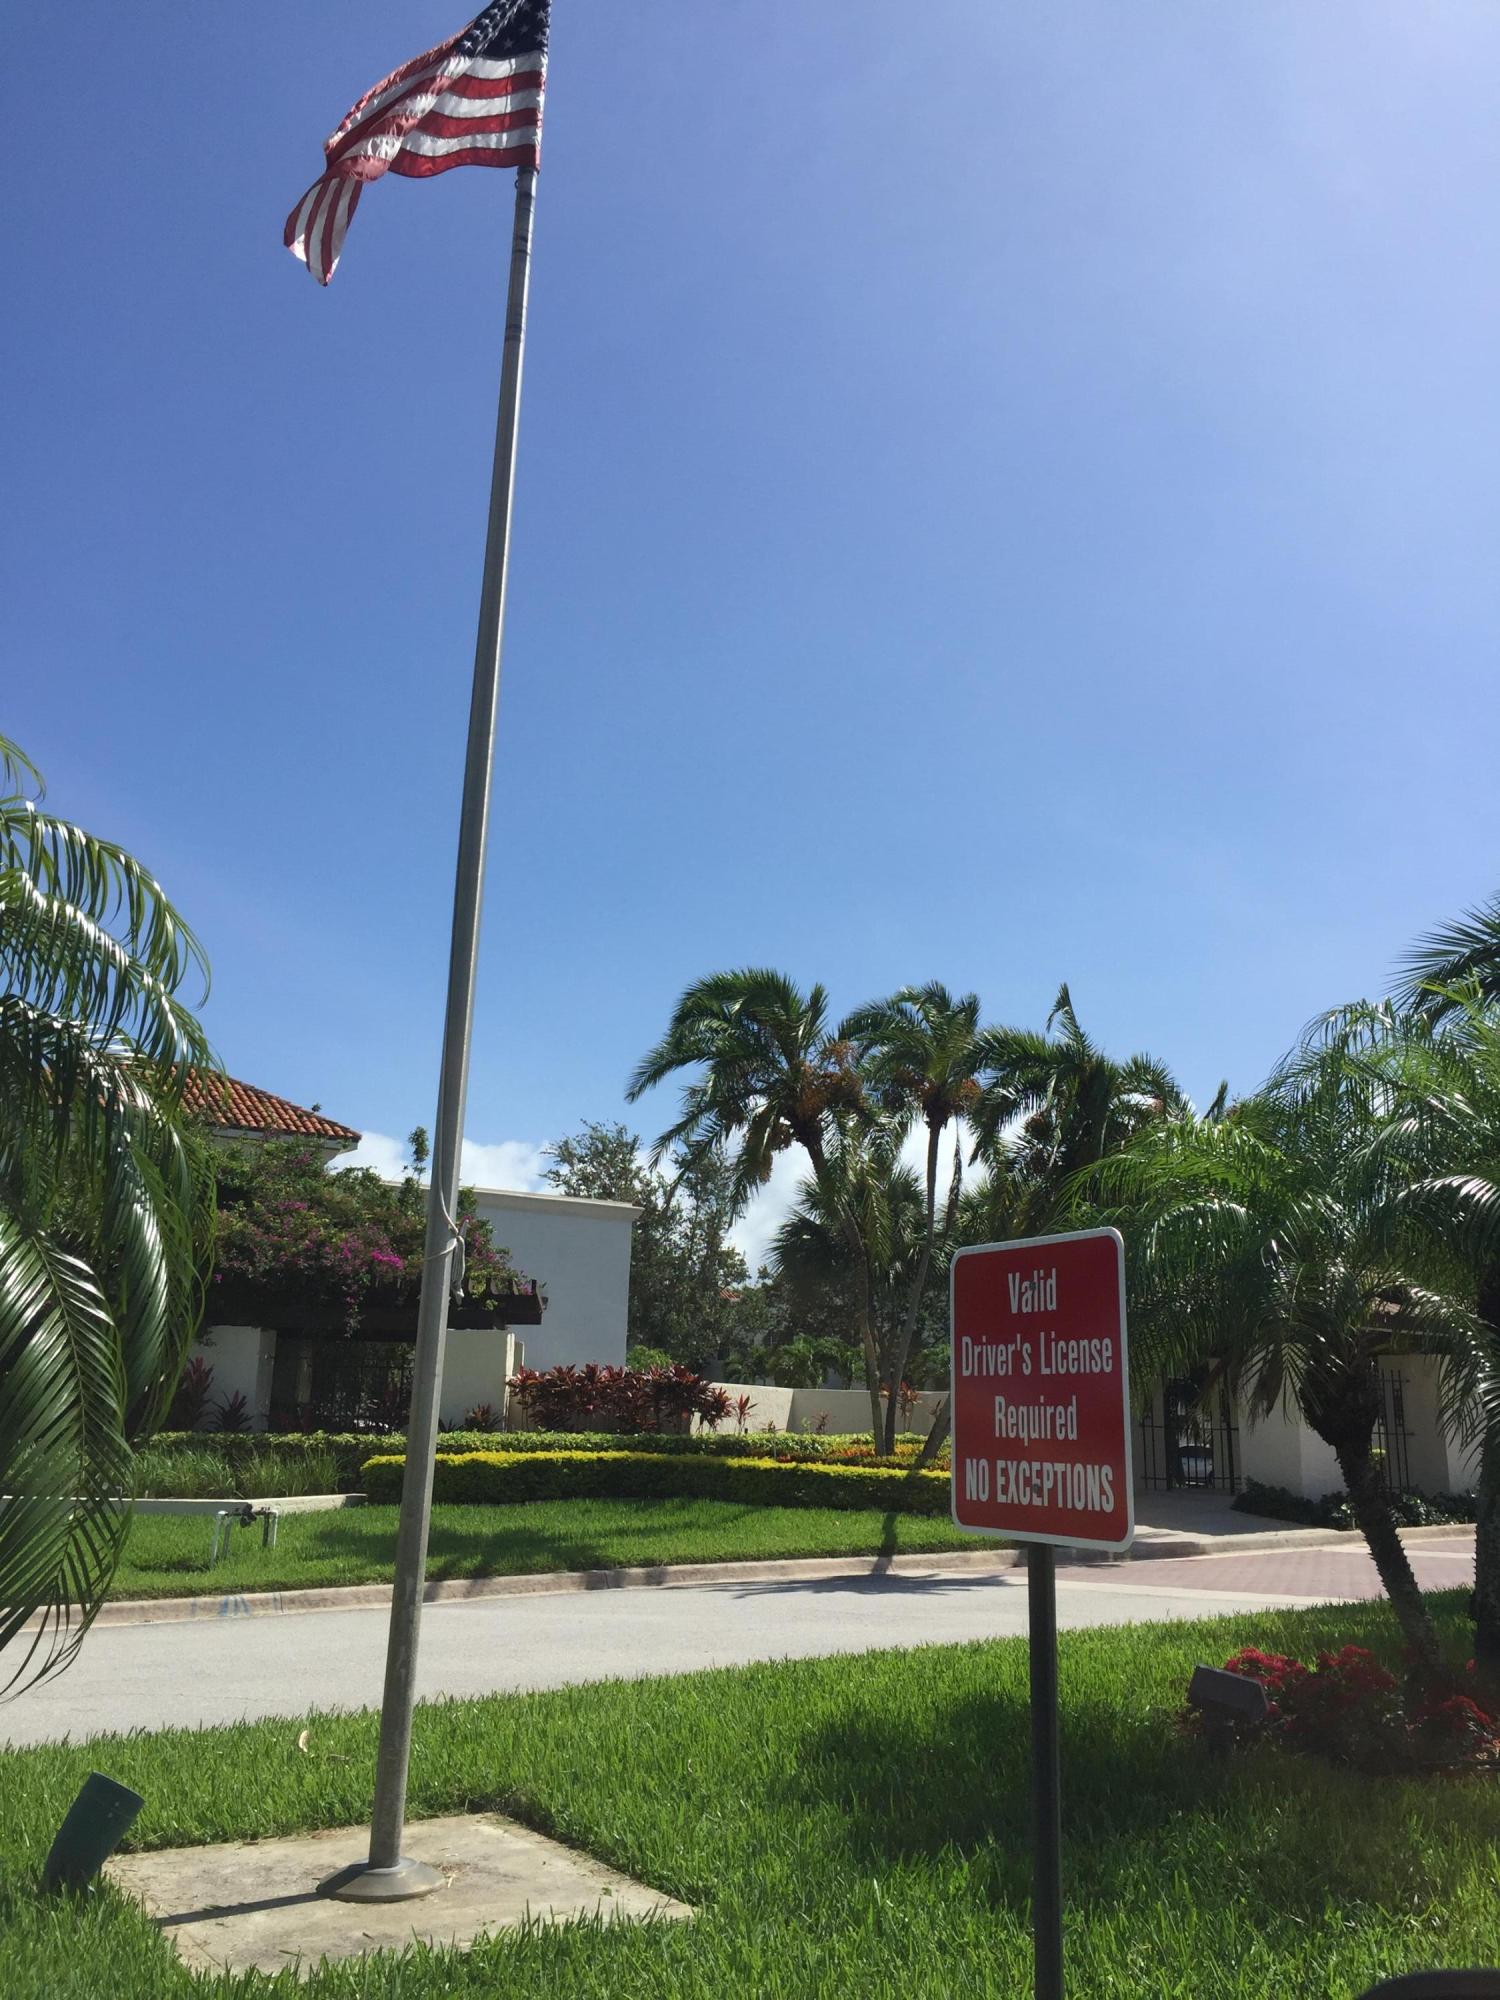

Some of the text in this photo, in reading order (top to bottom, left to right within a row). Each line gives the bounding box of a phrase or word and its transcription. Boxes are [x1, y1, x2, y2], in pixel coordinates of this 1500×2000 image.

[1008, 1267, 1057, 1314] Valid
[961, 1331, 1113, 1377] Driver's License
[994, 1395, 1078, 1446] Required
[965, 1458, 1115, 1513] NO EXCEPTIONS
